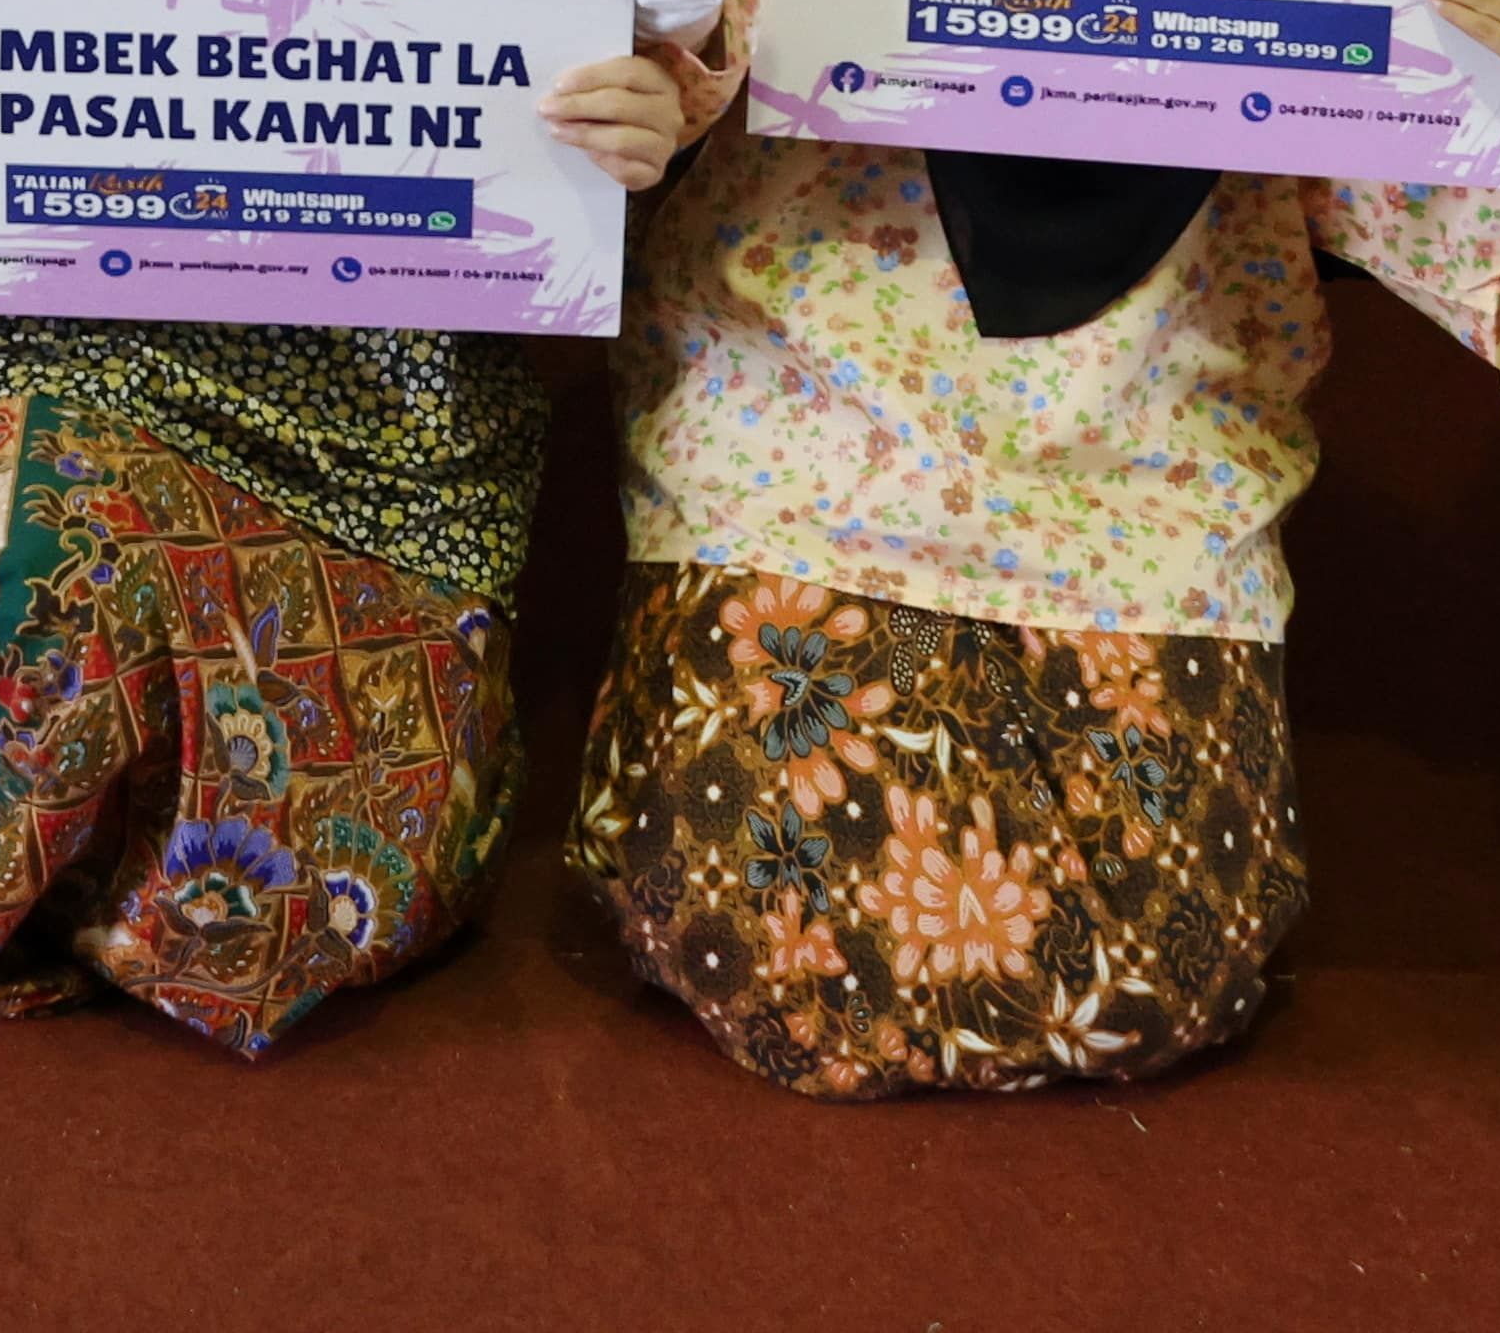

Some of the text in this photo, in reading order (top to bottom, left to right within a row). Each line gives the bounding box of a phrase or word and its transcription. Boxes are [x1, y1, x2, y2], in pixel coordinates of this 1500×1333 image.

[915, 5, 1074, 43] 15999
[1101, 13, 1139, 36] 24
[1152, 10, 1280, 40] Whatsapp
[197, 35, 441, 84] BEGHAT
[458, 43, 530, 86] LA
[1150, 33, 1338, 61] 019 26 15999
[1, 93, 482, 148] PASAL KAMI NI
[12, 175, 87, 190] TALIAN
[13, 191, 166, 220] 15999
[242, 189, 365, 211] Whatsapp
[242, 209, 423, 227] 019 26 15999
